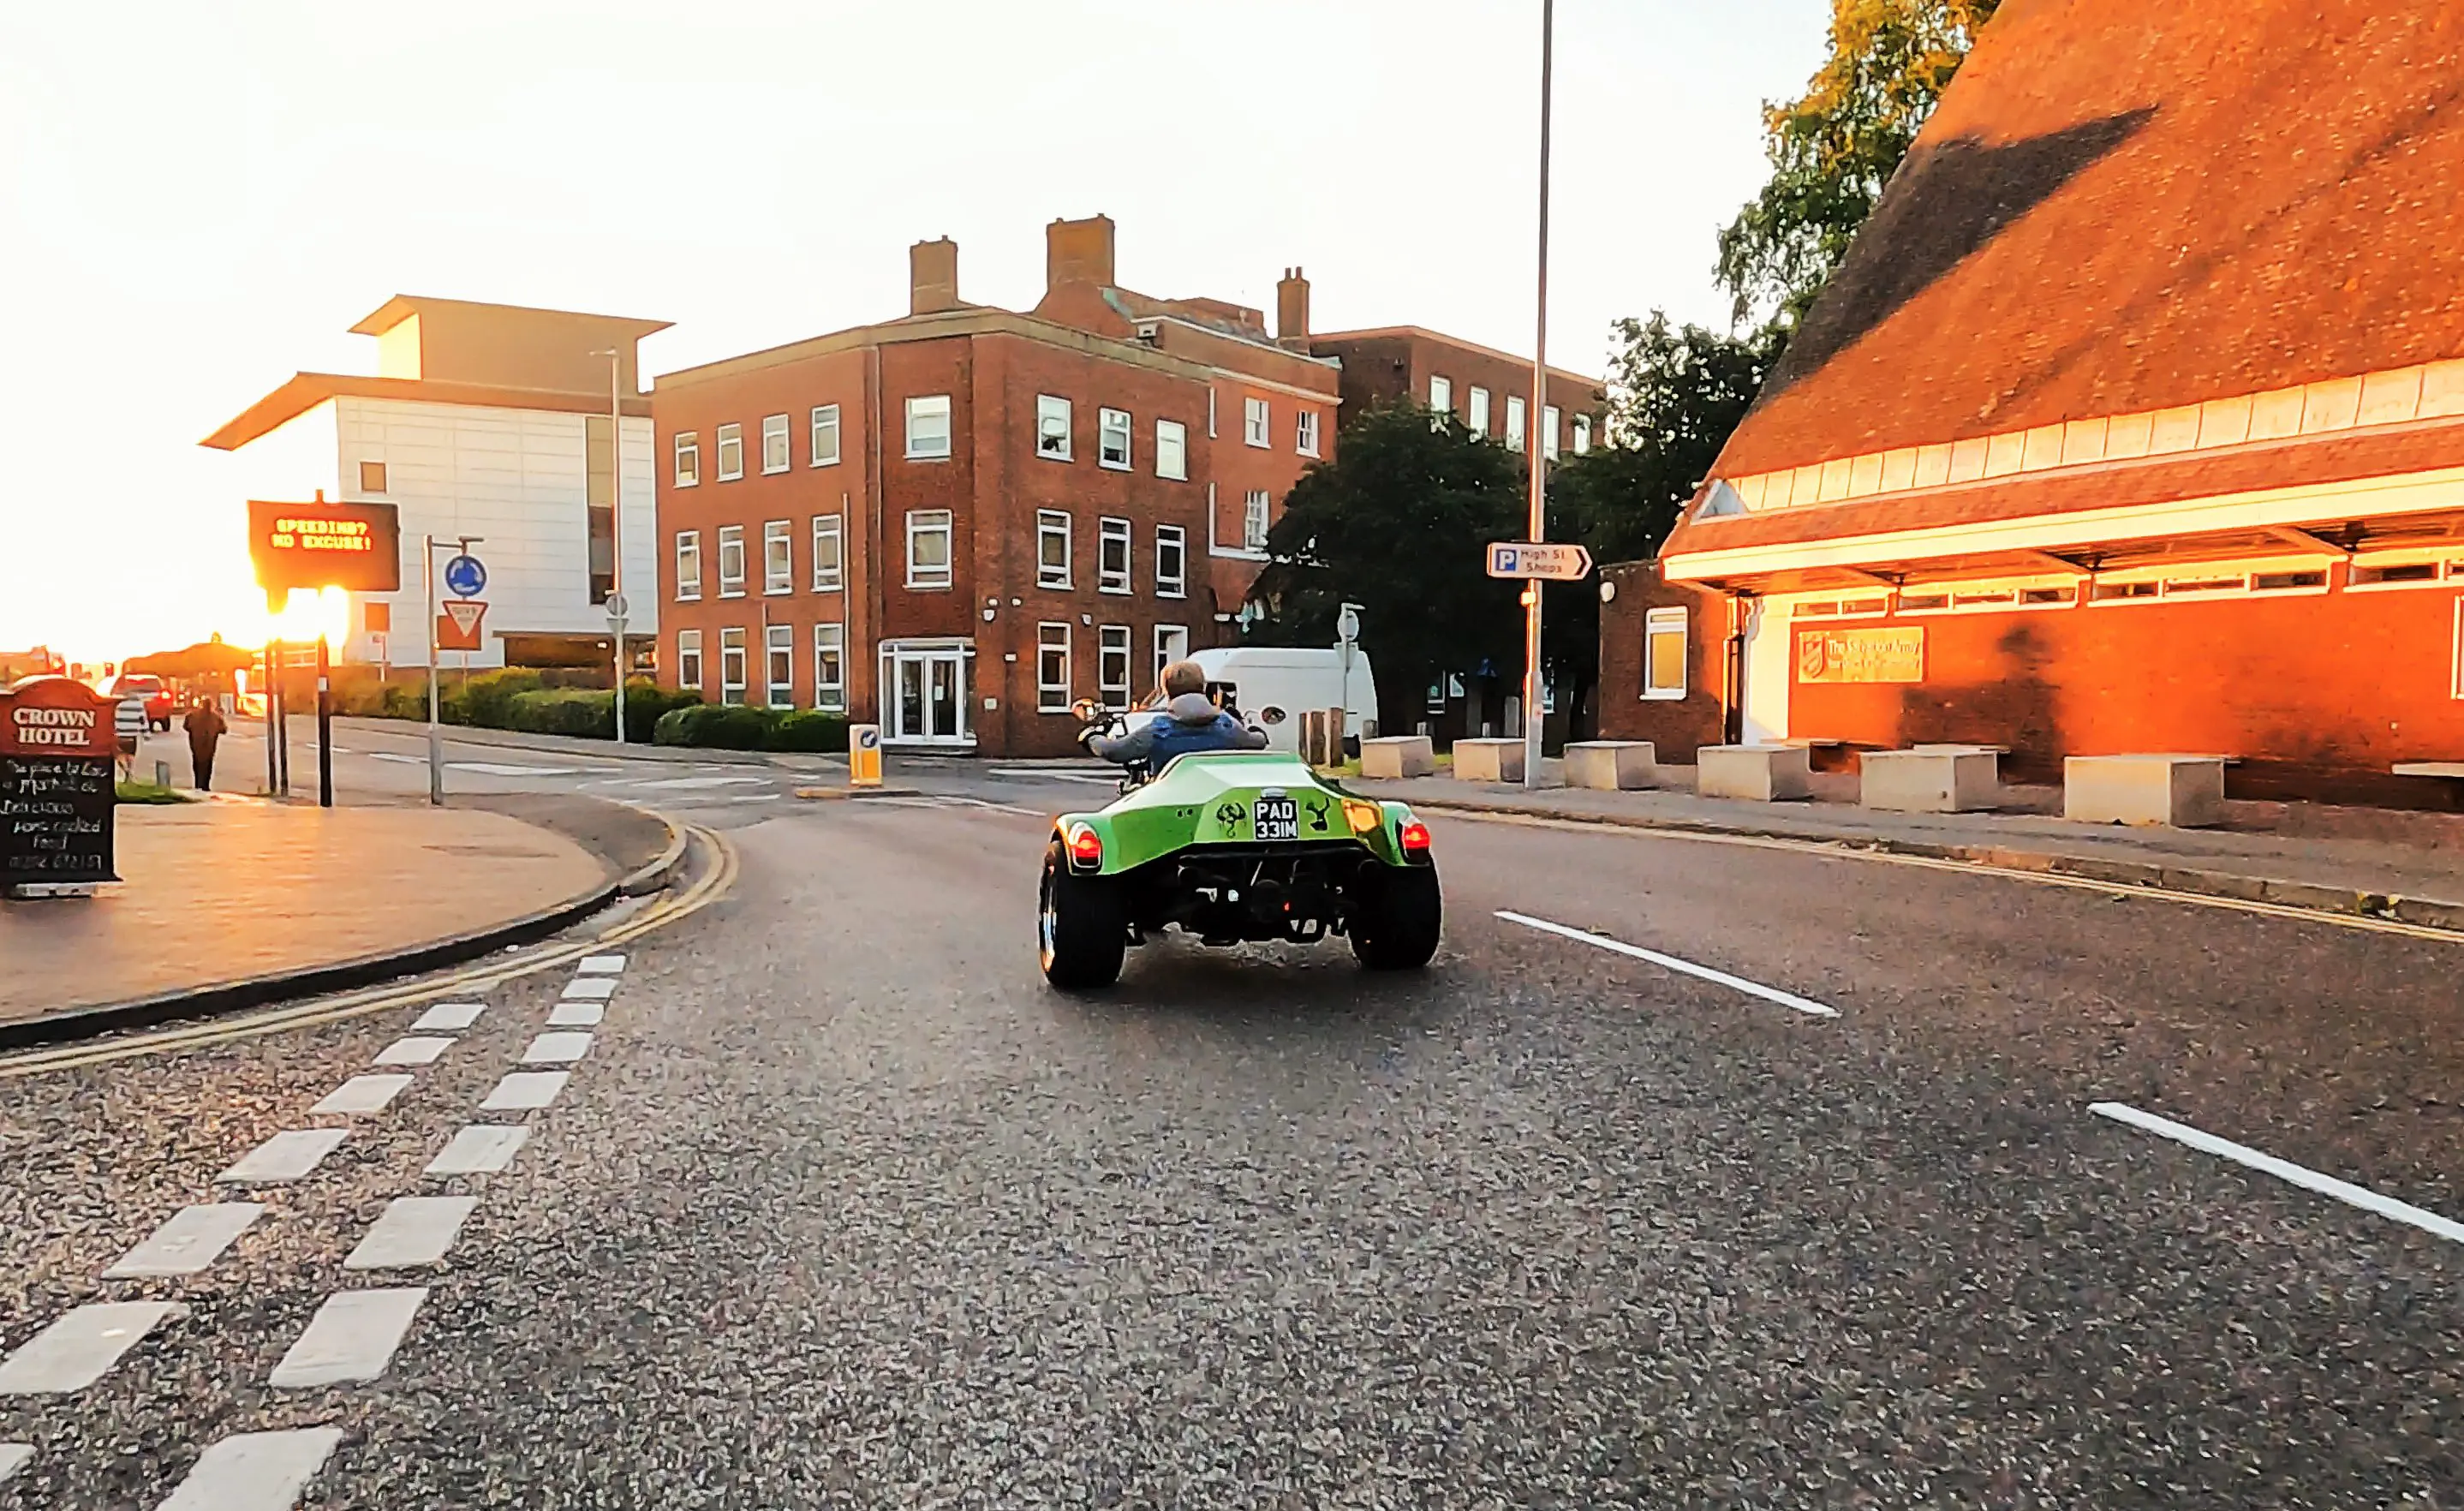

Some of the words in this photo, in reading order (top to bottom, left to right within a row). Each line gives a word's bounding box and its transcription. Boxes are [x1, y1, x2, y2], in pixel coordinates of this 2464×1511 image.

[276, 519, 367, 535] SPEEDING?
[271, 534, 295, 547] NO
[302, 535, 371, 550] EXCUSE!
[1521, 550, 1548, 560] High
[1526, 562, 1562, 573] Shops
[14, 708, 96, 727] CROWN
[19, 726, 90, 745] HOTEL
[1256, 802, 1293, 820] PAD
